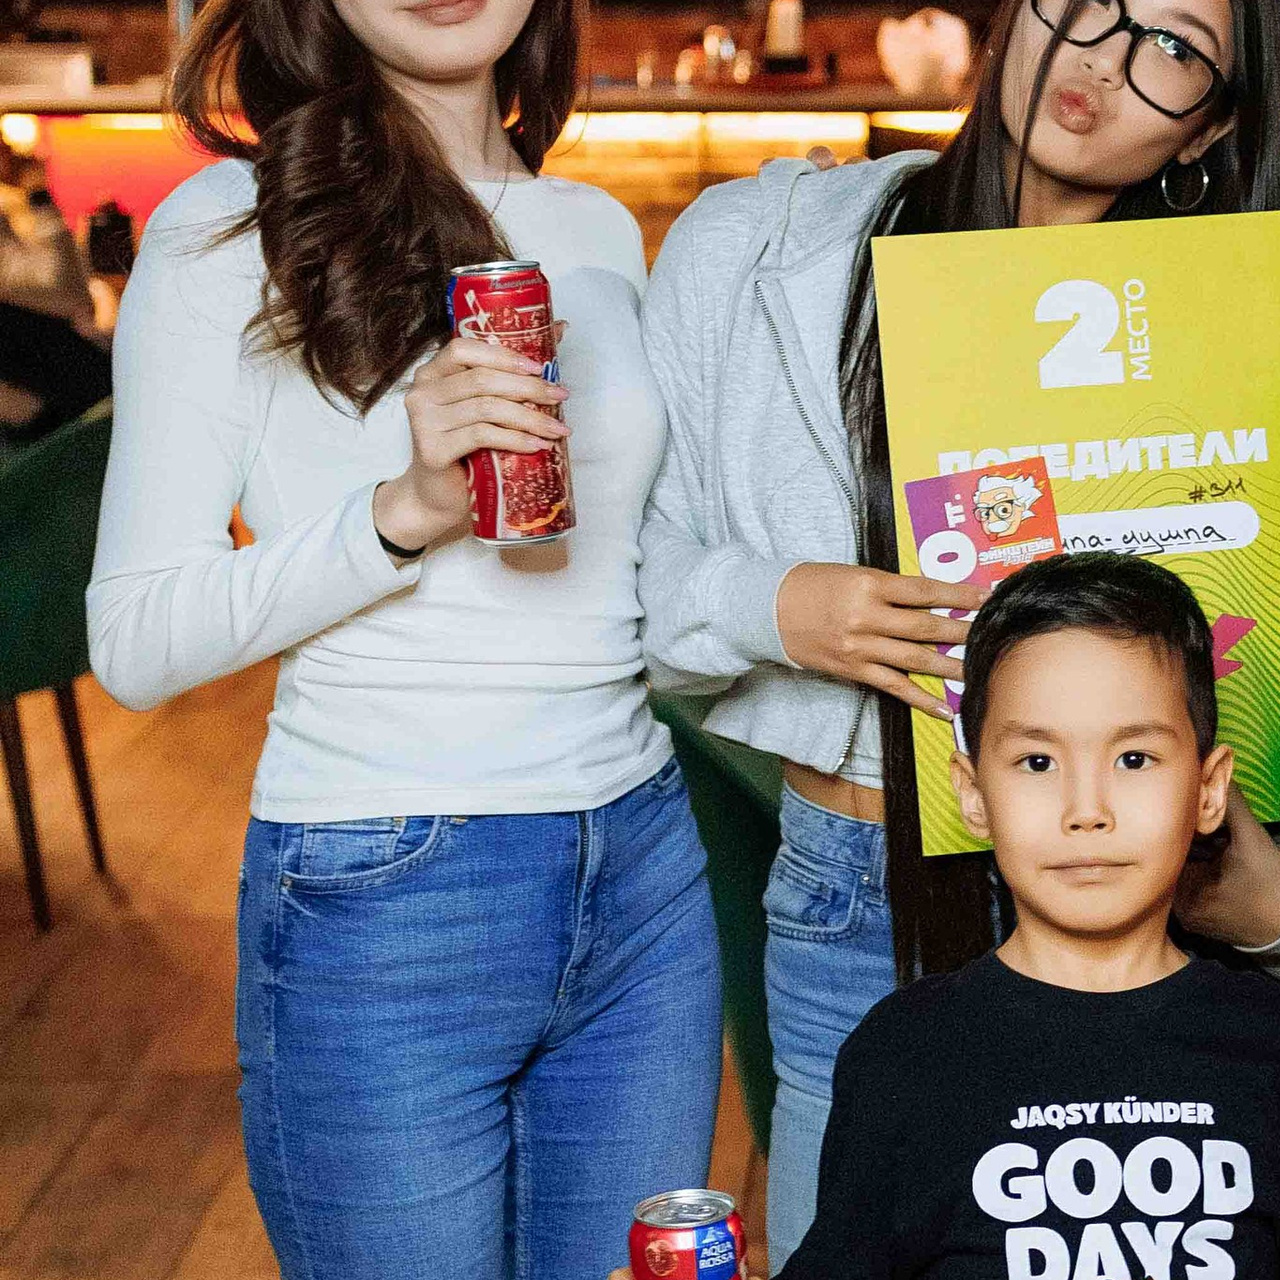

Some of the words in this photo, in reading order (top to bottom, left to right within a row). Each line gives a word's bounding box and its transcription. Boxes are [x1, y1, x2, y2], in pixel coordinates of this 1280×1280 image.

[1034, 279, 1125, 389] 2
[1122, 279, 1152, 381] МЕСТО
[1010, 1104, 1100, 1130] JAQSY
[1103, 1096, 1215, 1125] KÜNDER
[972, 1136, 1254, 1222] GOOD
